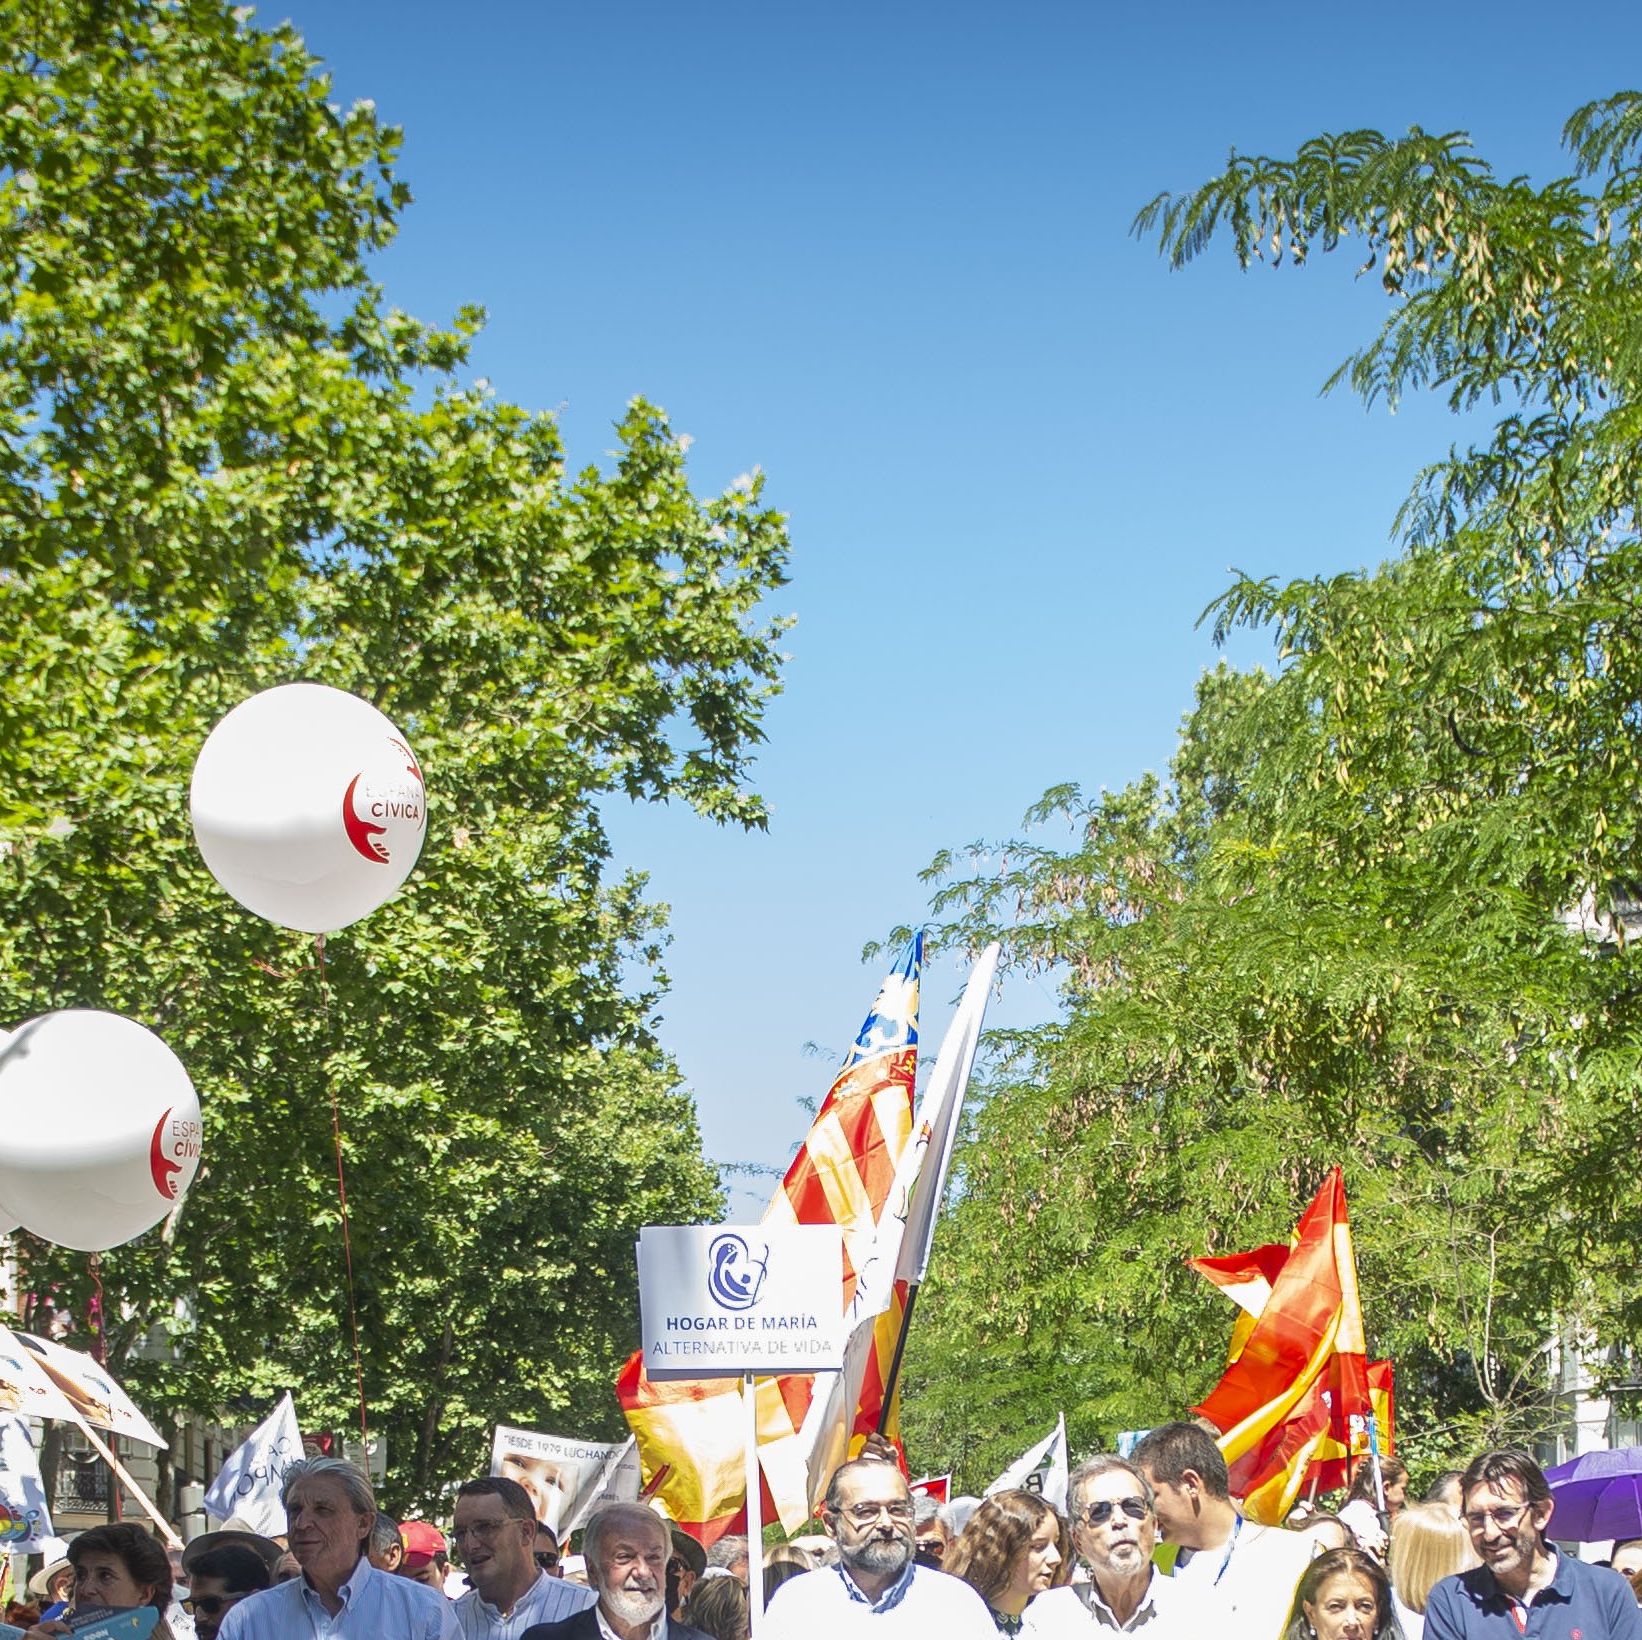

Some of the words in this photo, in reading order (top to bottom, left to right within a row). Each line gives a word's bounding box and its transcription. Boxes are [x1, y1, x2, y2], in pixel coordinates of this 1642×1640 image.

[371, 800, 420, 820] CÍVICA
[666, 1316, 729, 1331] HOGAR
[734, 1316, 756, 1330] DE
[762, 1313, 817, 1330] MARÍA
[652, 1340, 761, 1355] ALTERNATIVA
[767, 1340, 788, 1354] DE
[793, 1340, 833, 1353] VIDA
[537, 1440, 562, 1455] 1979
